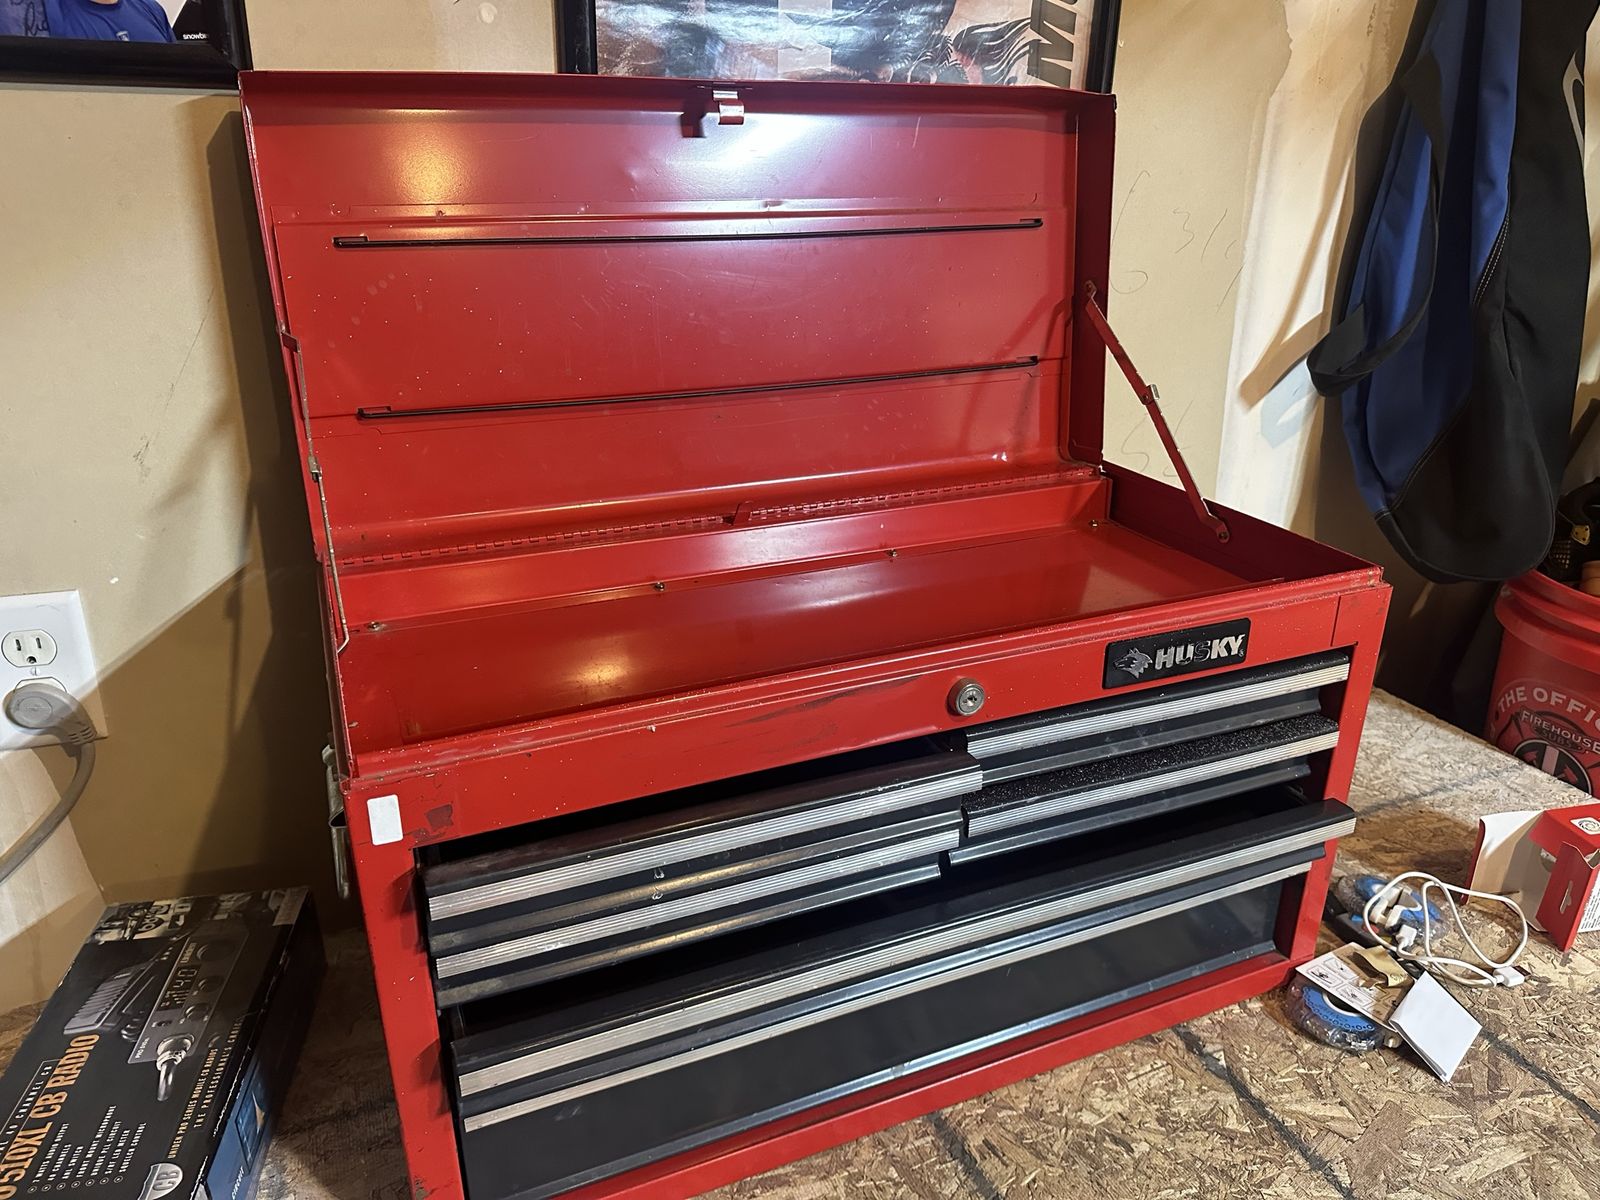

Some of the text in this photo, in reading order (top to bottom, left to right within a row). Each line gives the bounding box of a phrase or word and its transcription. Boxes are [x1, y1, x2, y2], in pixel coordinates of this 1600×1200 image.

[1154, 633, 1246, 670] HUSKY
[1498, 686, 1528, 713] THE
[1521, 710, 1600, 754] FIREHOUSE
[45, 1034, 100, 1088] RADIO
[29, 1091, 68, 1119] CB
